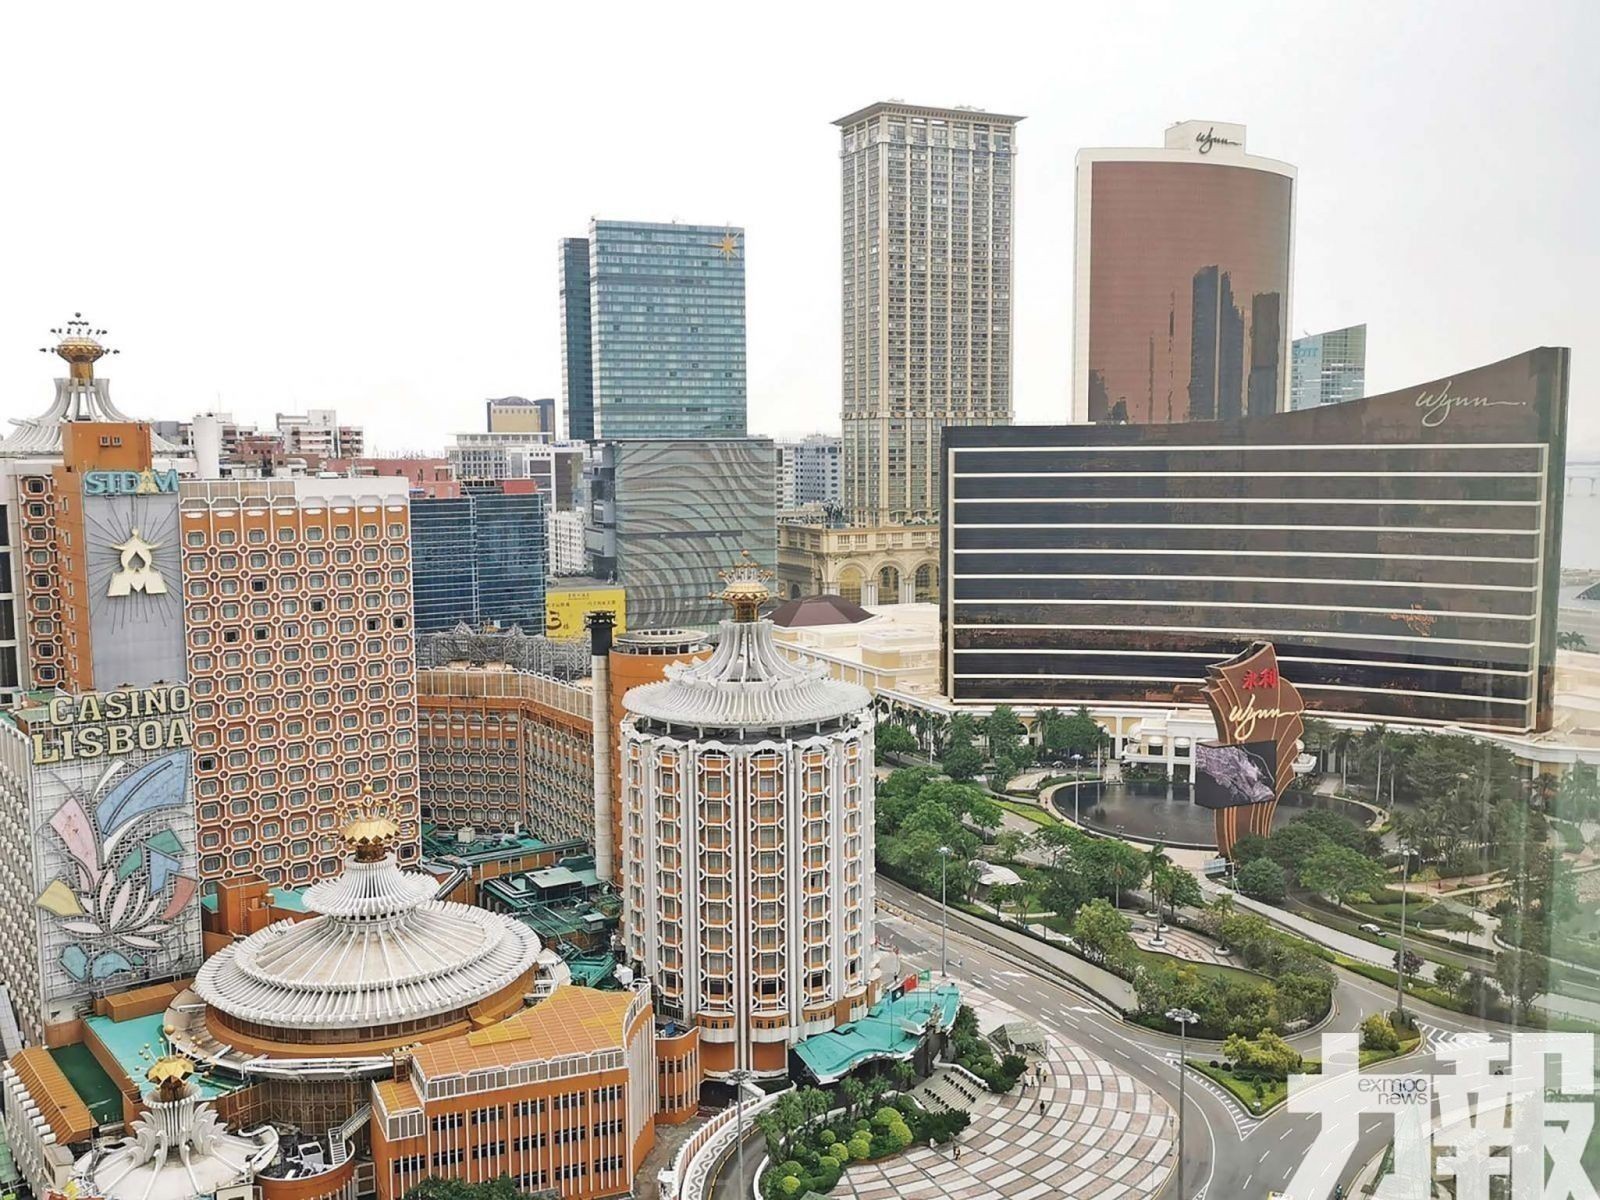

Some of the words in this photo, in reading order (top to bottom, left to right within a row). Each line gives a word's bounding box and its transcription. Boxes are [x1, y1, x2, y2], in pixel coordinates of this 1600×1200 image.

[1243, 668, 1277, 690] 永利
[49, 685, 191, 726] CASINO
[31, 717, 193, 765] LISBOA
